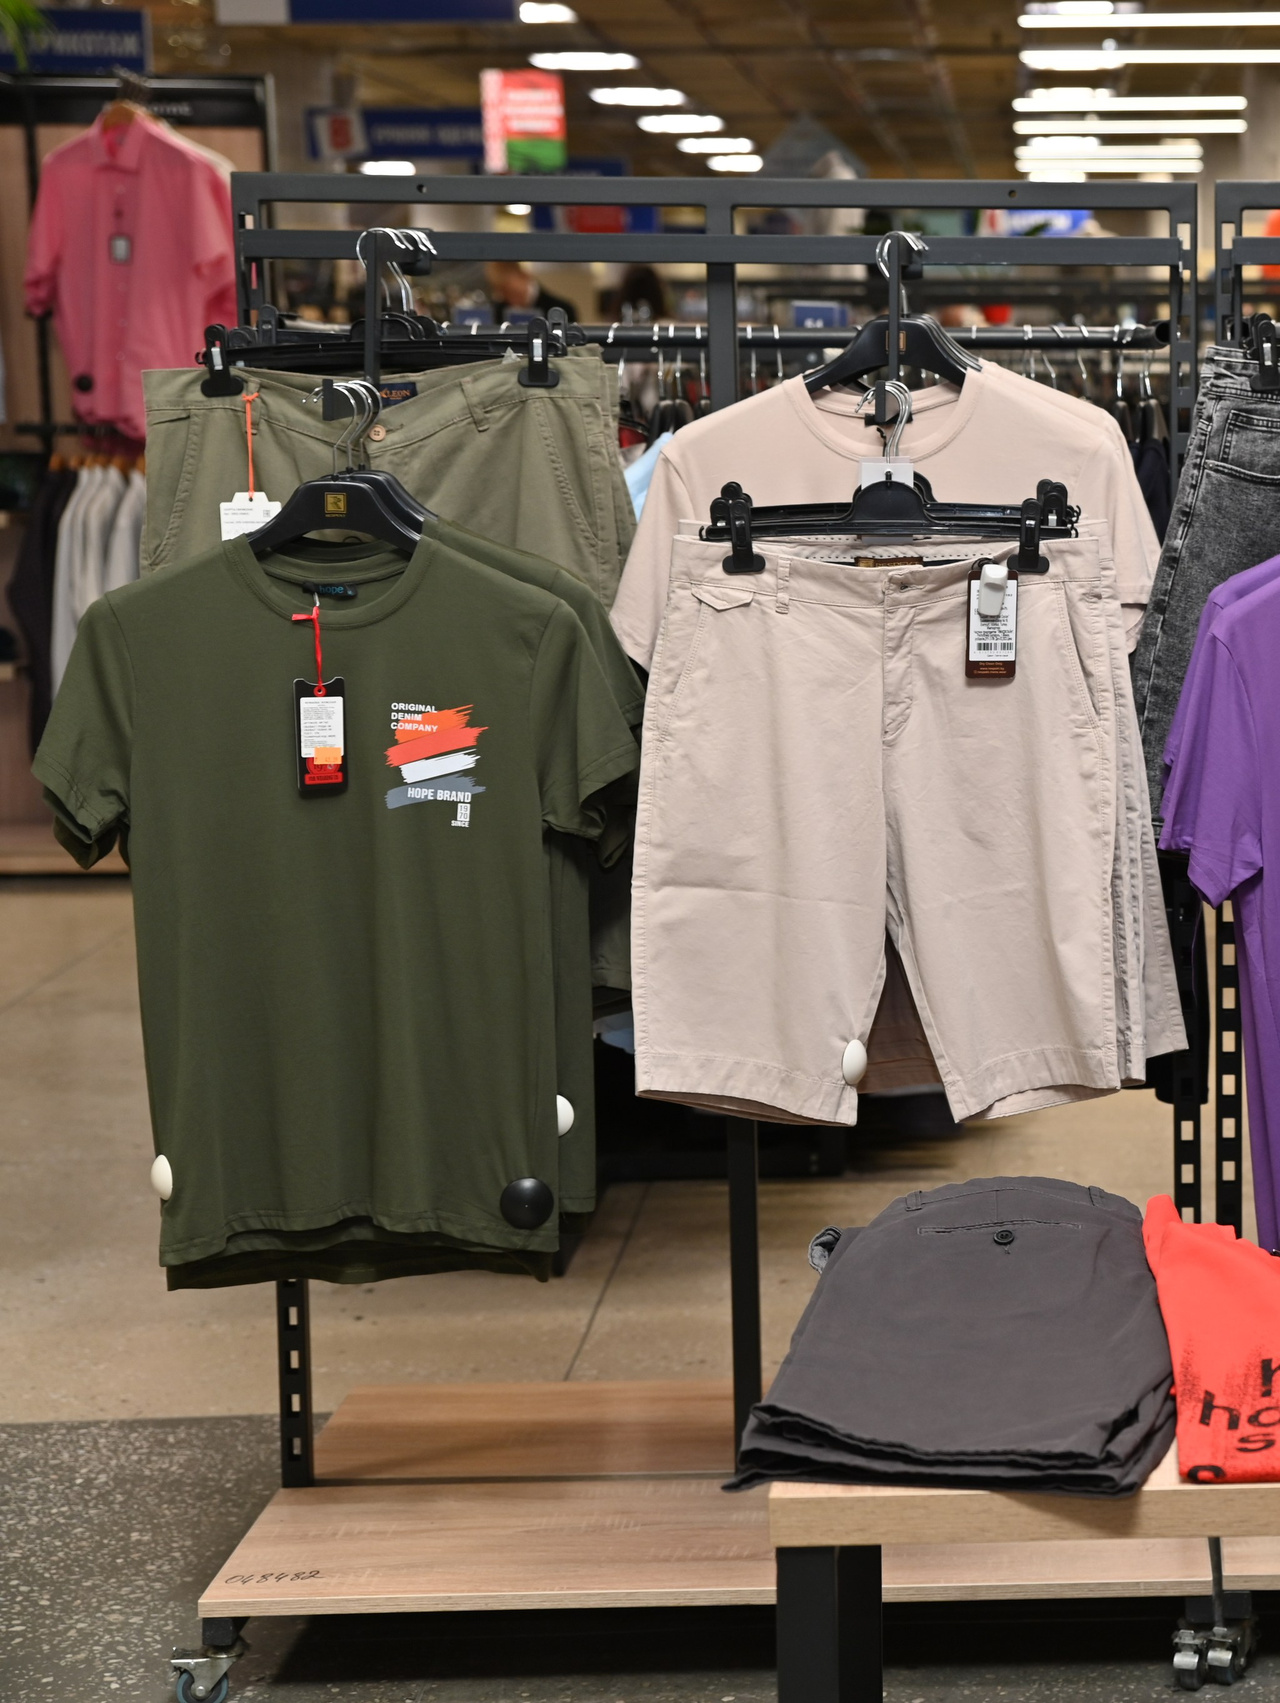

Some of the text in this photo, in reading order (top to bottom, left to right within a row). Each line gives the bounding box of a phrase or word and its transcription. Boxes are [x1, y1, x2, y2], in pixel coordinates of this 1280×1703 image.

[319, 586, 344, 595] hope
[391, 703, 438, 713] ORIGINAL
[391, 712, 422, 721] DENIM
[390, 722, 438, 732] COMPANY
[408, 787, 472, 803] HOPE BRAND
[451, 820, 469, 828] SINCE
